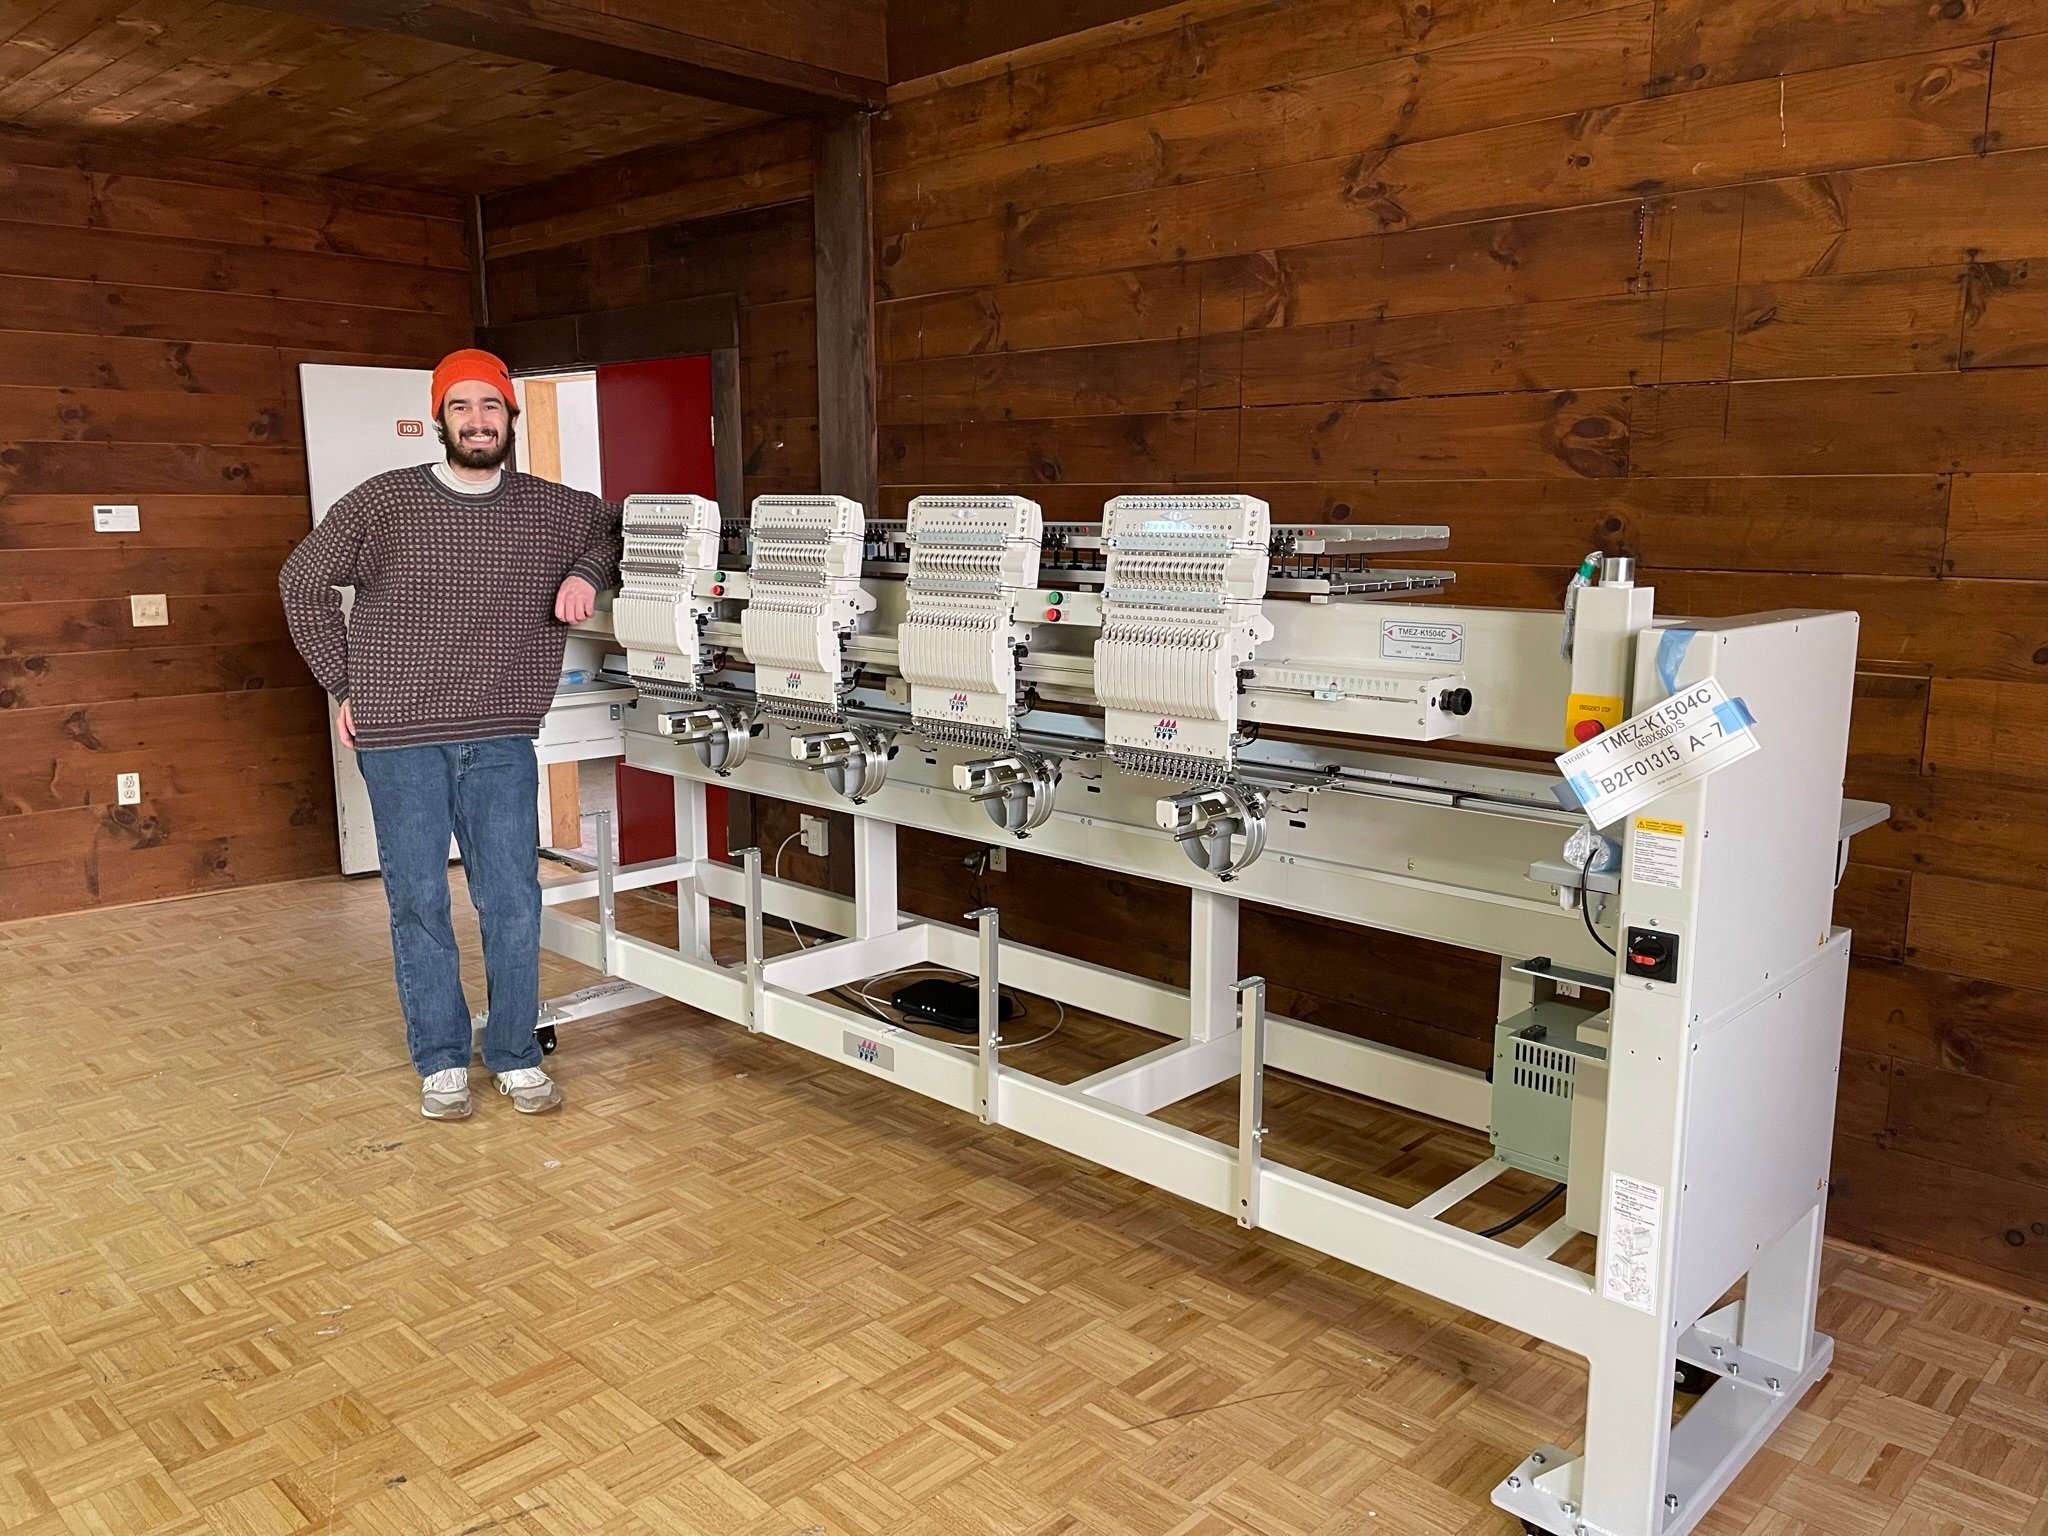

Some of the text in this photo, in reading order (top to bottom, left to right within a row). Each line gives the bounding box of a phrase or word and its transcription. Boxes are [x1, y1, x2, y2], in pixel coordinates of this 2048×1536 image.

[403, 425, 418, 433] 103
[1398, 627, 1447, 638] TMEZ-K1504C
[1153, 726, 1178, 734] TAJIMA
[1563, 688, 1711, 766] MODEL TMEZ-K1504C
[1601, 745, 1680, 793] B2F01315
[1689, 721, 1725, 753] A-7
